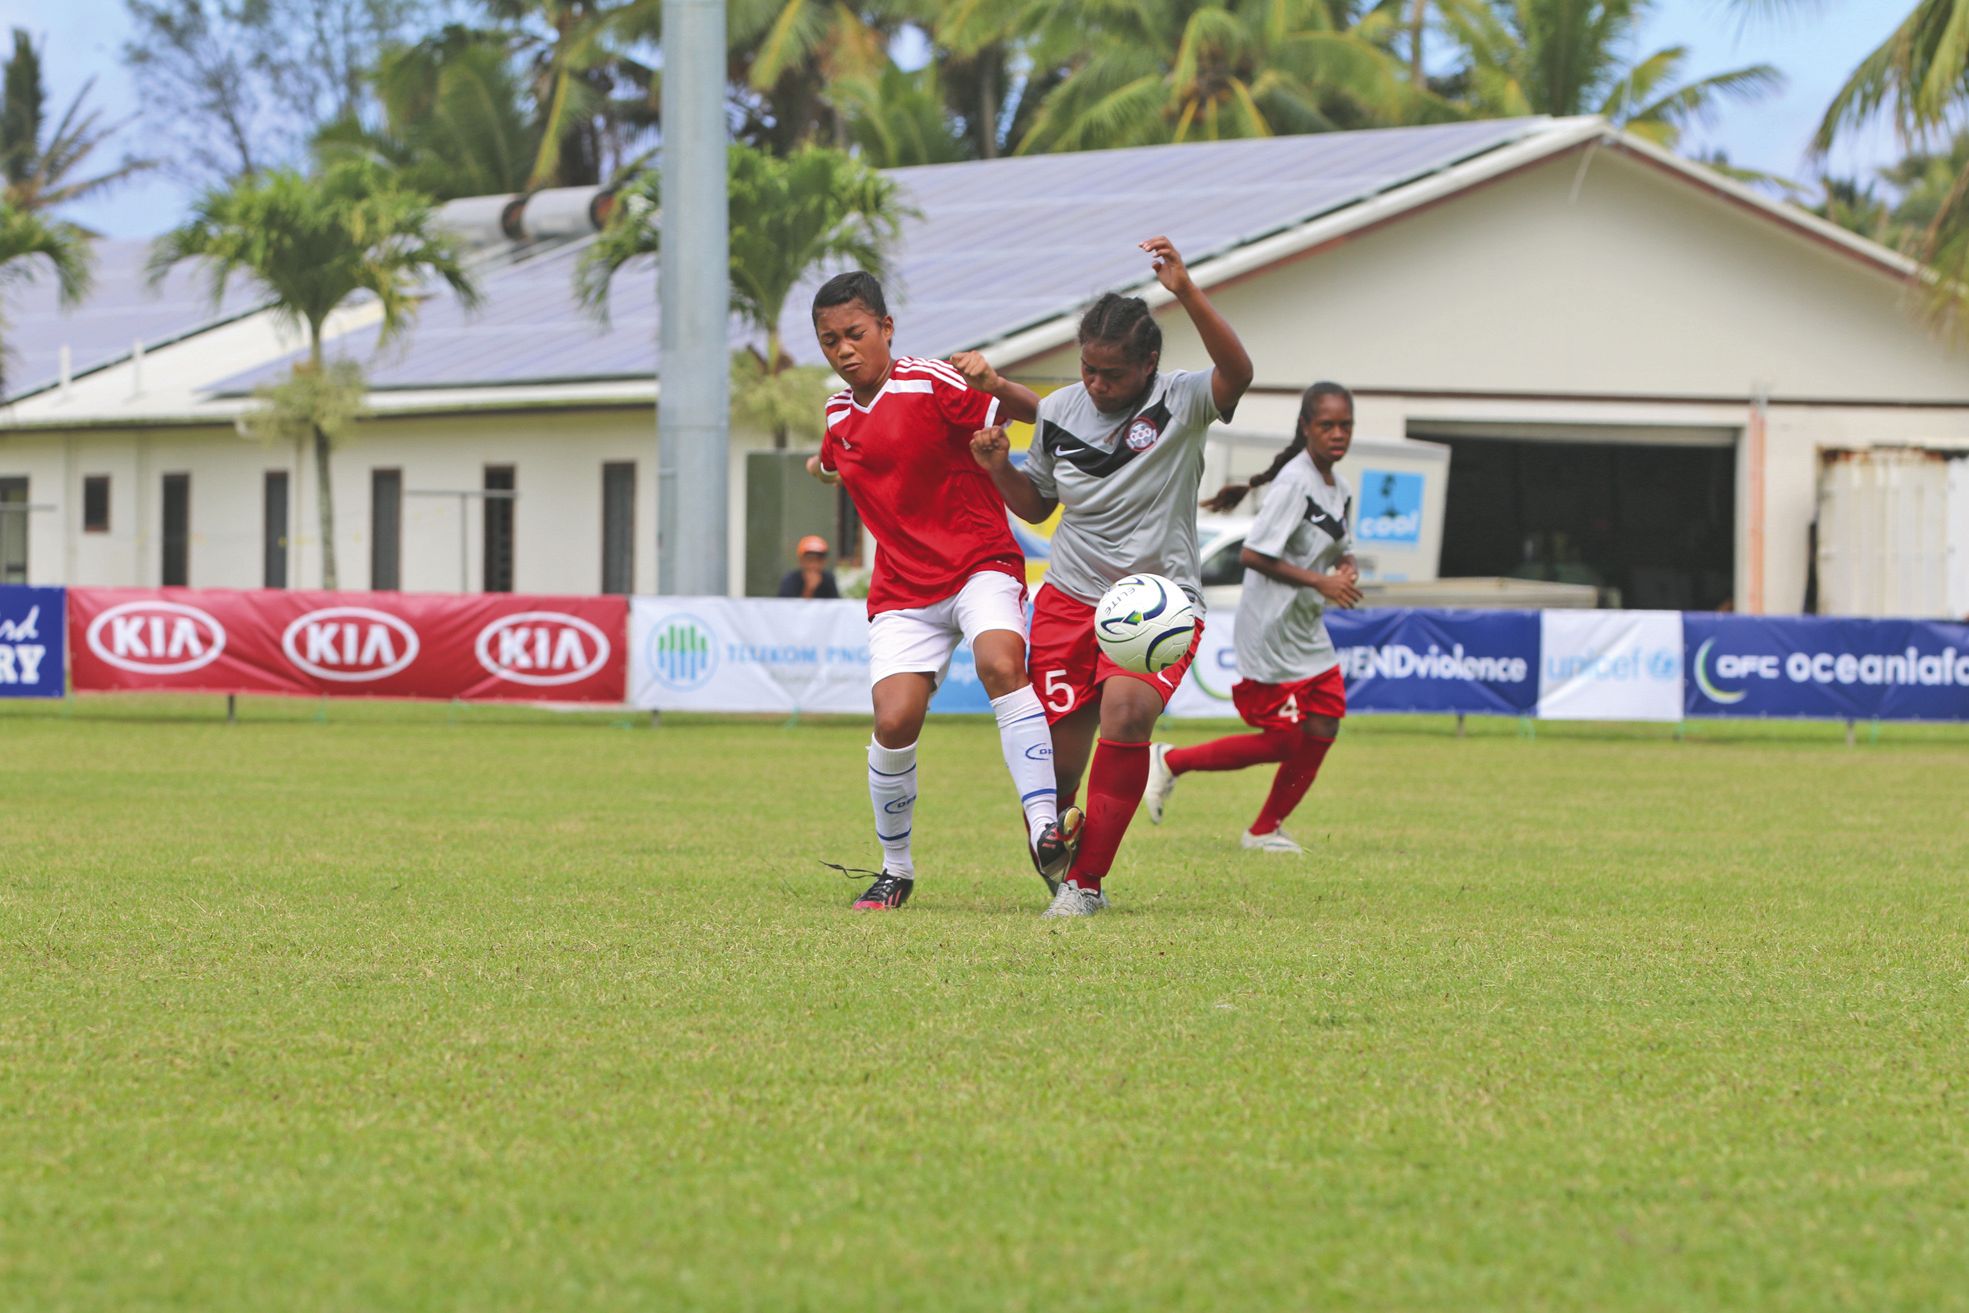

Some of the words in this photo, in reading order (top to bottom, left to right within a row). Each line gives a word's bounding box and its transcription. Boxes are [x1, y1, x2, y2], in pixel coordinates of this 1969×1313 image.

[1104, 587, 1136, 616] ELITE
[111, 615, 206, 658] KIA
[305, 622, 397, 666] KIA
[500, 626, 589, 670] KIA
[1716, 654, 1781, 680] OFC
[1045, 669, 1075, 713] 5
[1278, 693, 1300, 723] 4
